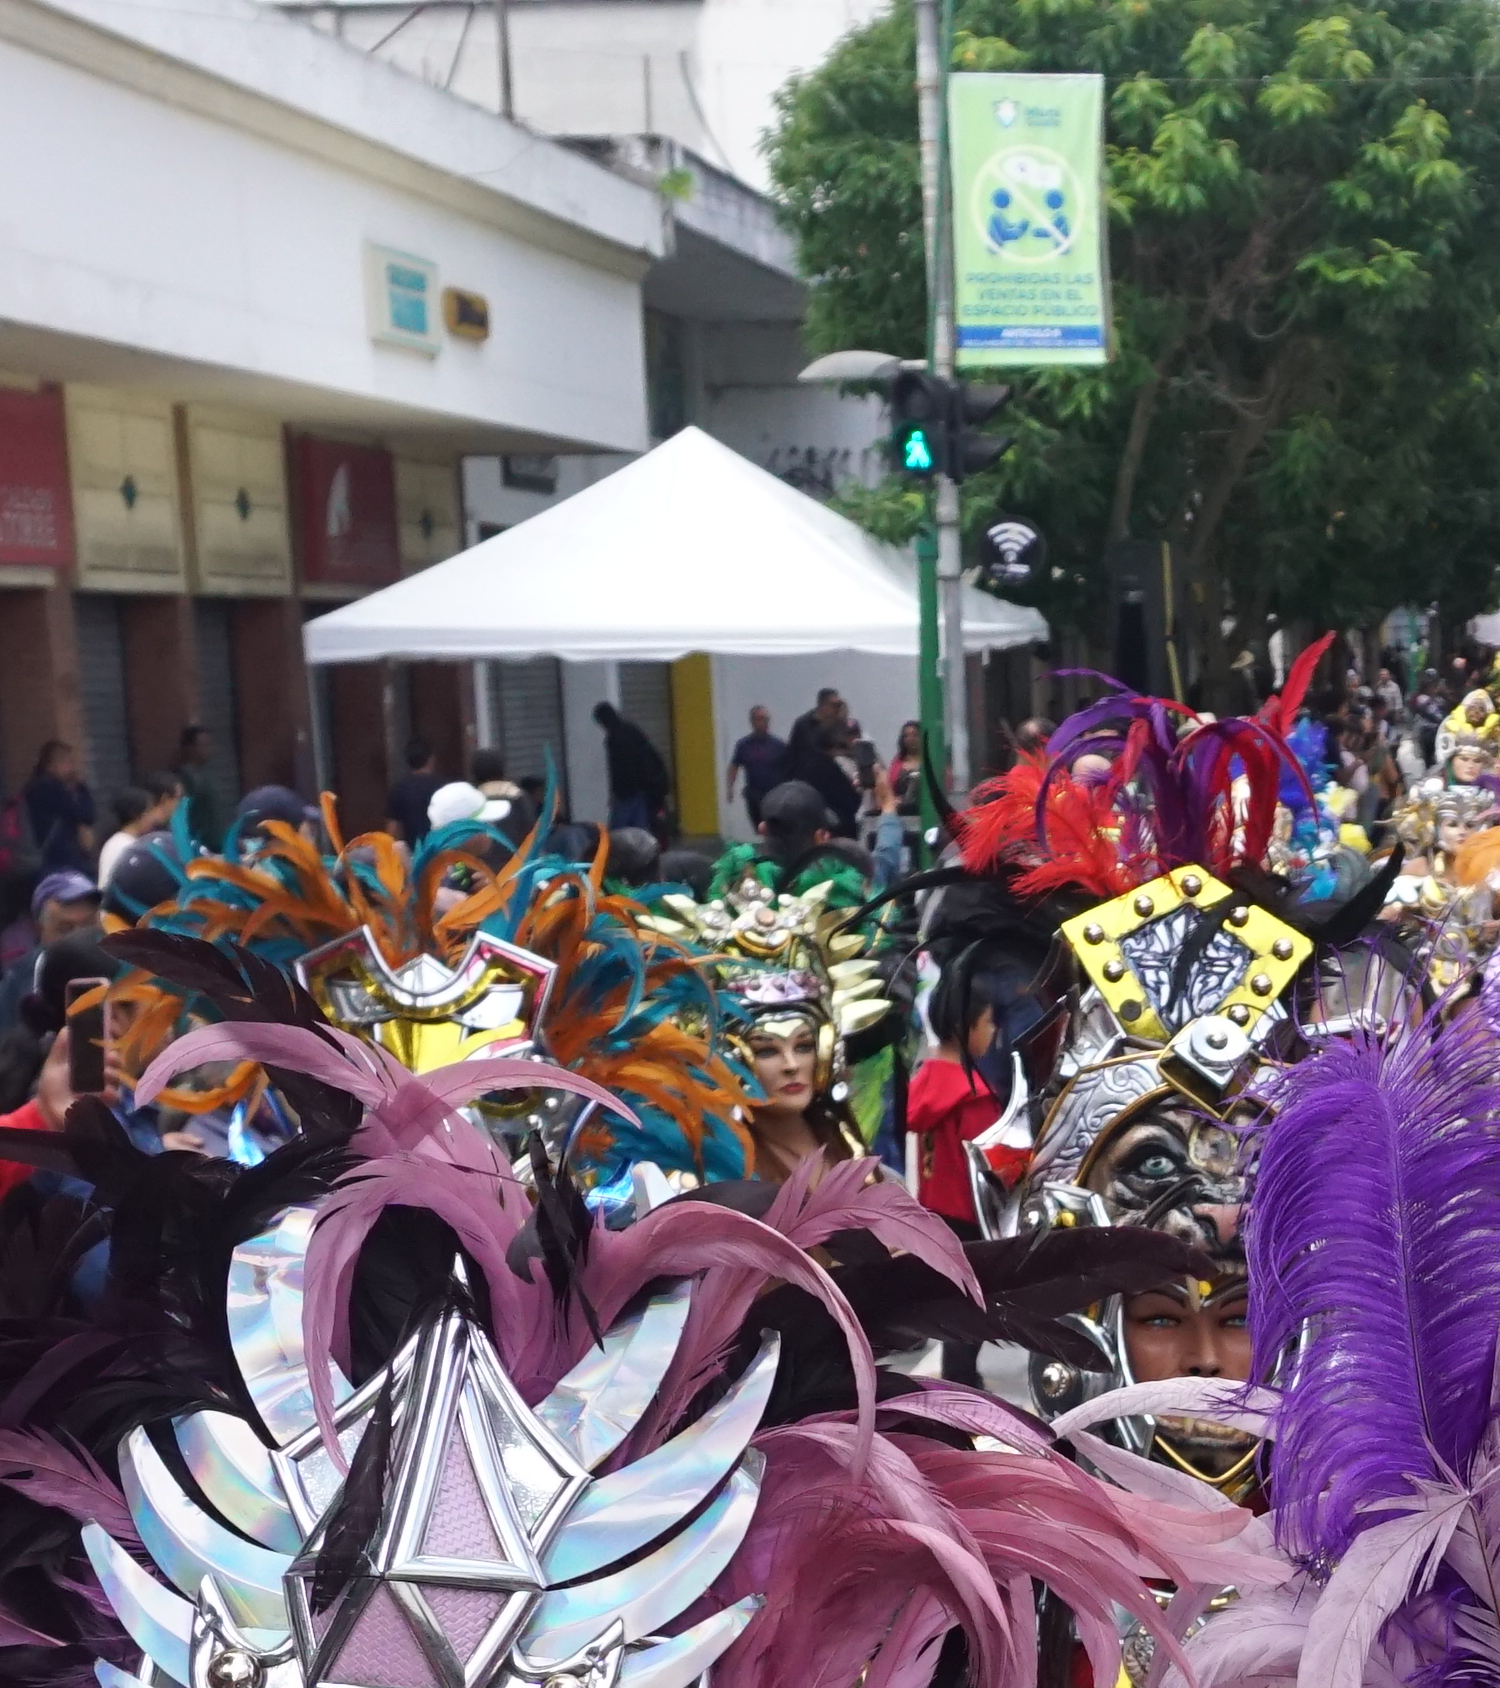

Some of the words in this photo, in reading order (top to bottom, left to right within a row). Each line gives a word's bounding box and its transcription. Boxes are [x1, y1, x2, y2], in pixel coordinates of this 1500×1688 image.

[965, 272, 1061, 285] PROHIBIDAS
[1066, 273, 1094, 285] LAS
[979, 288, 1037, 300] VENTAS
[1040, 288, 1062, 300] EN
[1066, 288, 1084, 300] EL
[962, 304, 1030, 316] ESPACIO
